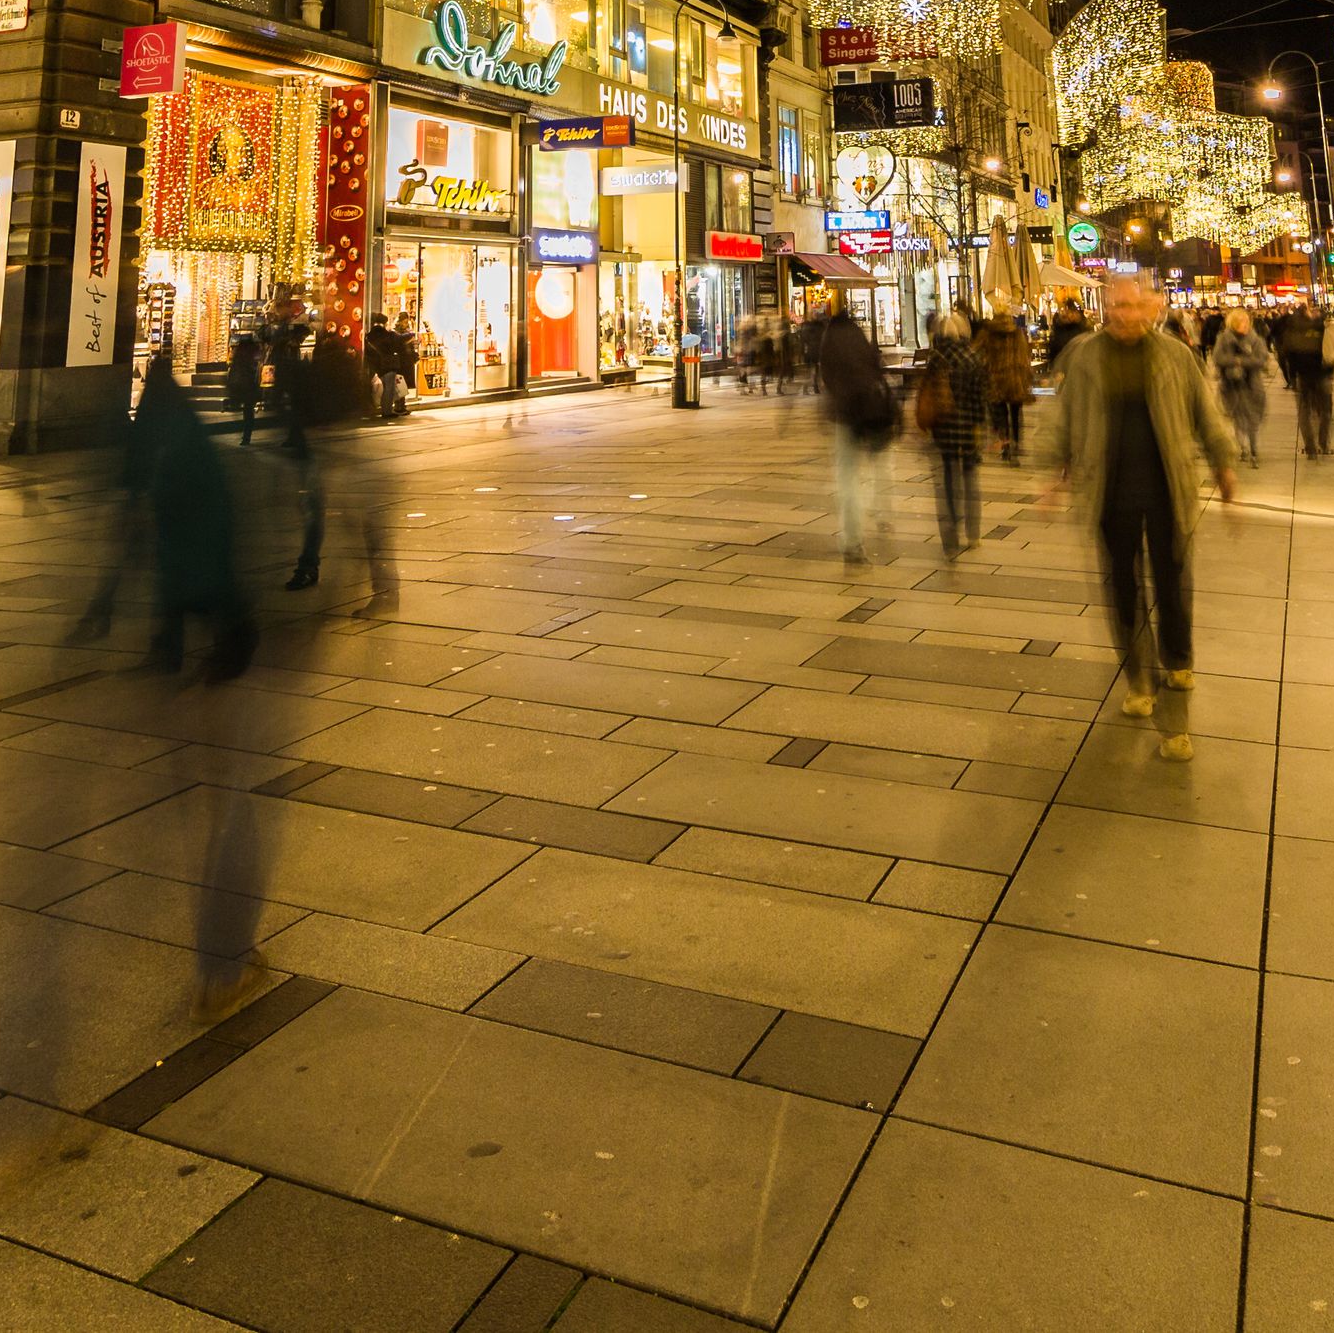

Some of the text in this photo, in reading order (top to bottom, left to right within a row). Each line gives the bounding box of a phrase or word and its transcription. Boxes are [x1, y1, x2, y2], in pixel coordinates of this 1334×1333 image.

[425, 0, 568, 96] Dohnal
[126, 56, 171, 68] SHOETASTIC
[893, 82, 922, 108] LOOS
[66, 110, 76, 123] 12
[599, 82, 747, 150] HAUS DES KINDES
[556, 126, 601, 142] Tchibo
[432, 175, 507, 213] Tchibo
[332, 207, 359, 219] Mirabell
[892, 238, 931, 251] ROVSKI
[84, 179, 110, 353] Best of AUSTRIA
